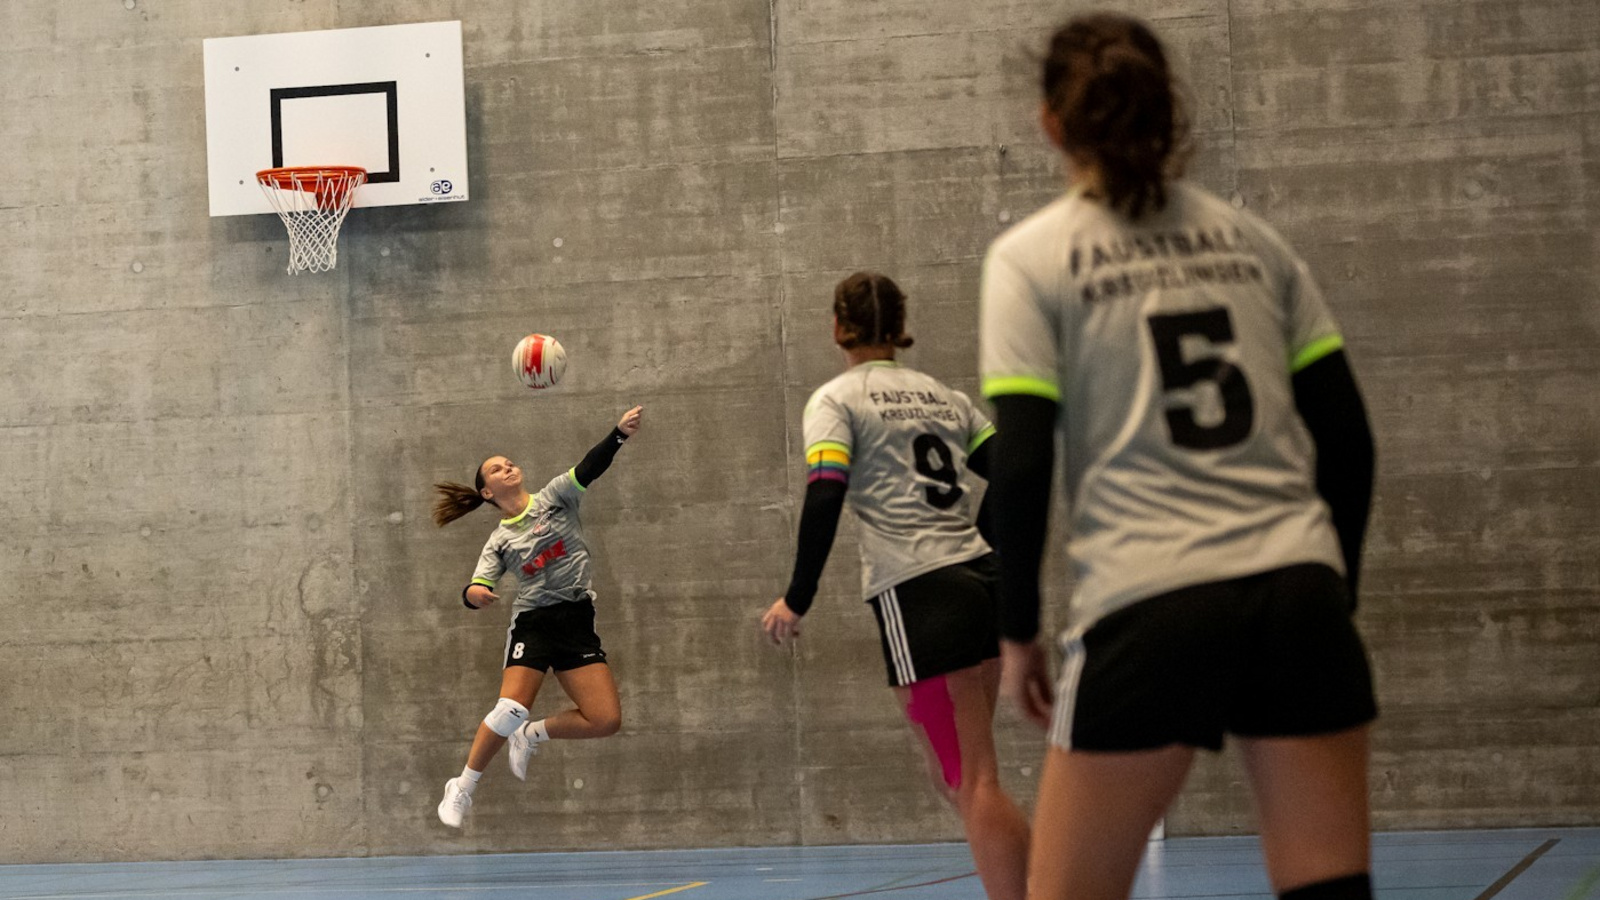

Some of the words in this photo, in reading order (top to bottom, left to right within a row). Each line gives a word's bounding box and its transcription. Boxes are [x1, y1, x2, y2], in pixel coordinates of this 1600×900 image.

[1147, 307, 1254, 453] 5
[913, 434, 963, 509] 9
[512, 642, 525, 659] 8
